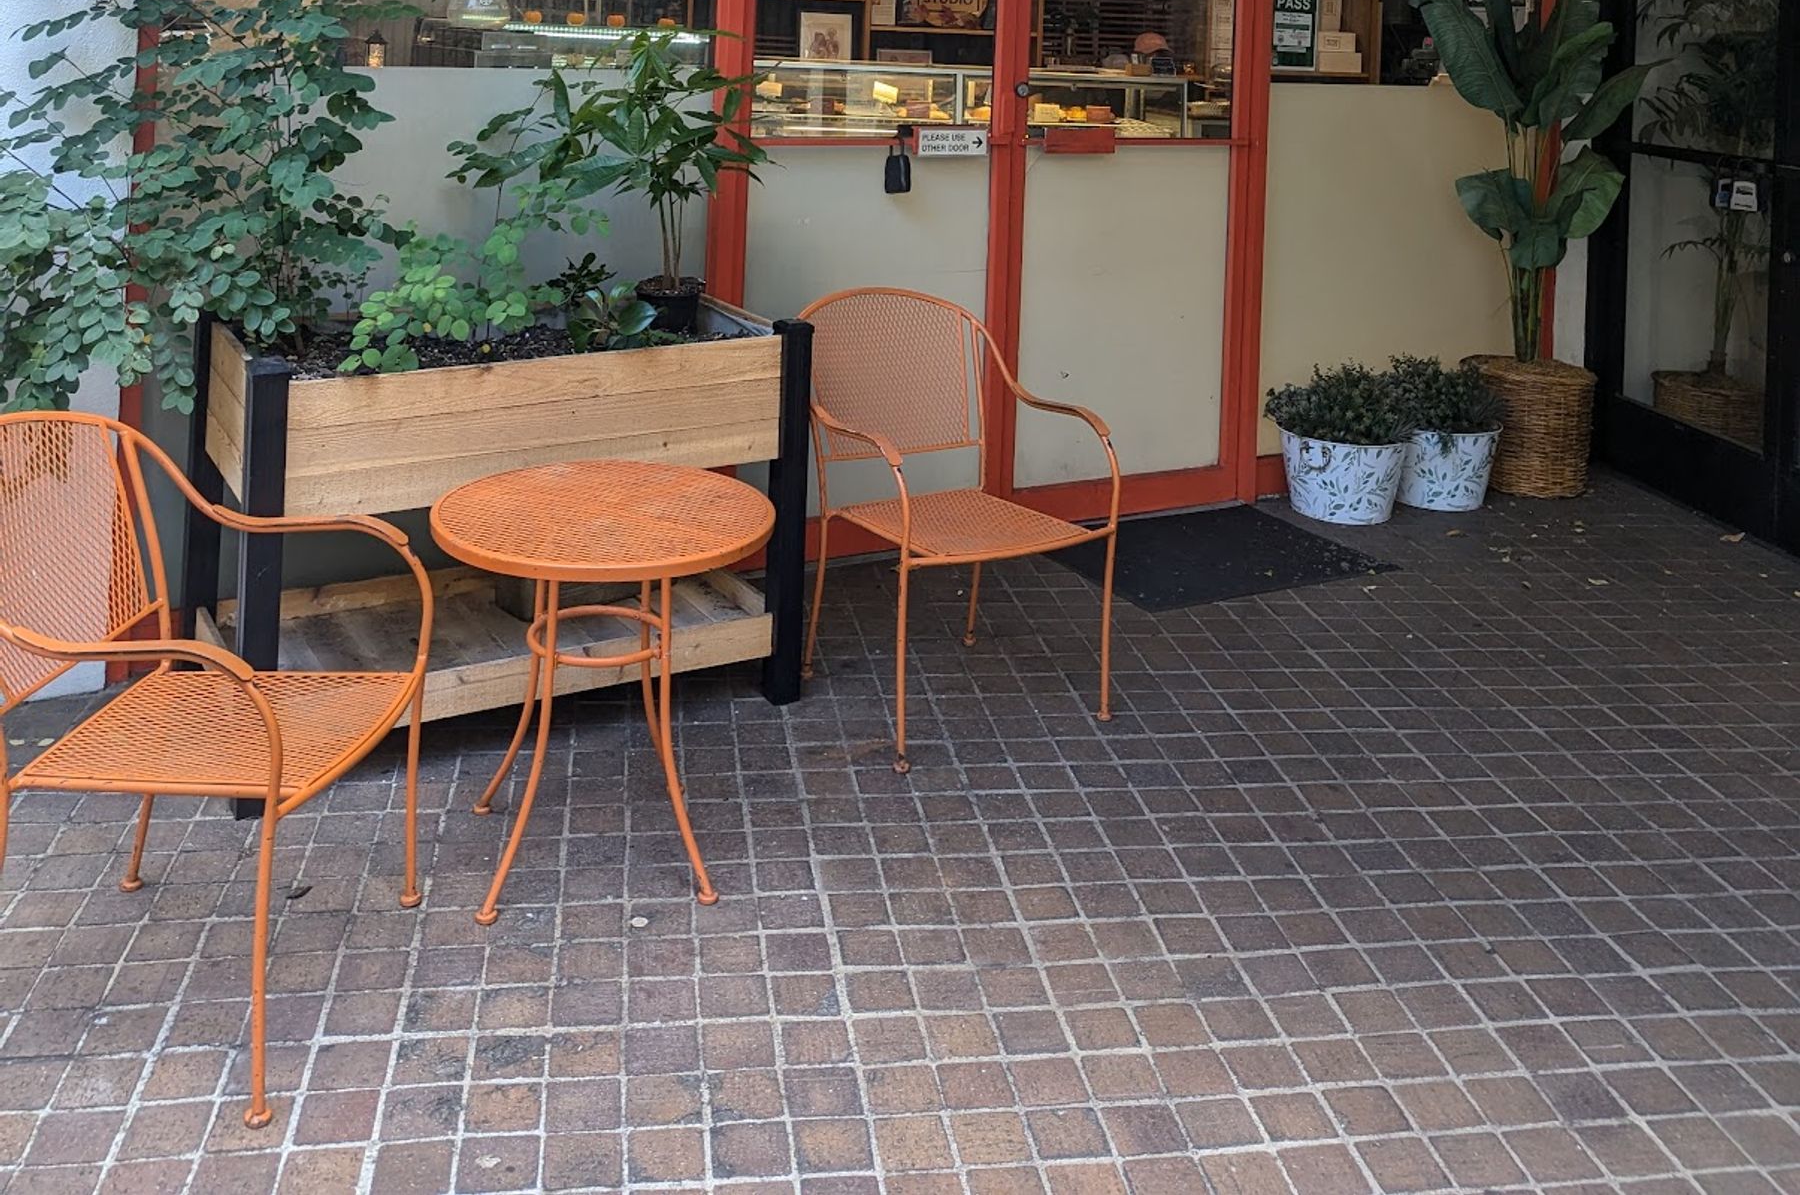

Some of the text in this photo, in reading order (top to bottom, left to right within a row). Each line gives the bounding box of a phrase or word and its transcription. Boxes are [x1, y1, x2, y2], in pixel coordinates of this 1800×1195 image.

[922, 133, 966, 142] PLEASE USE
[921, 144, 946, 152] OTHER
